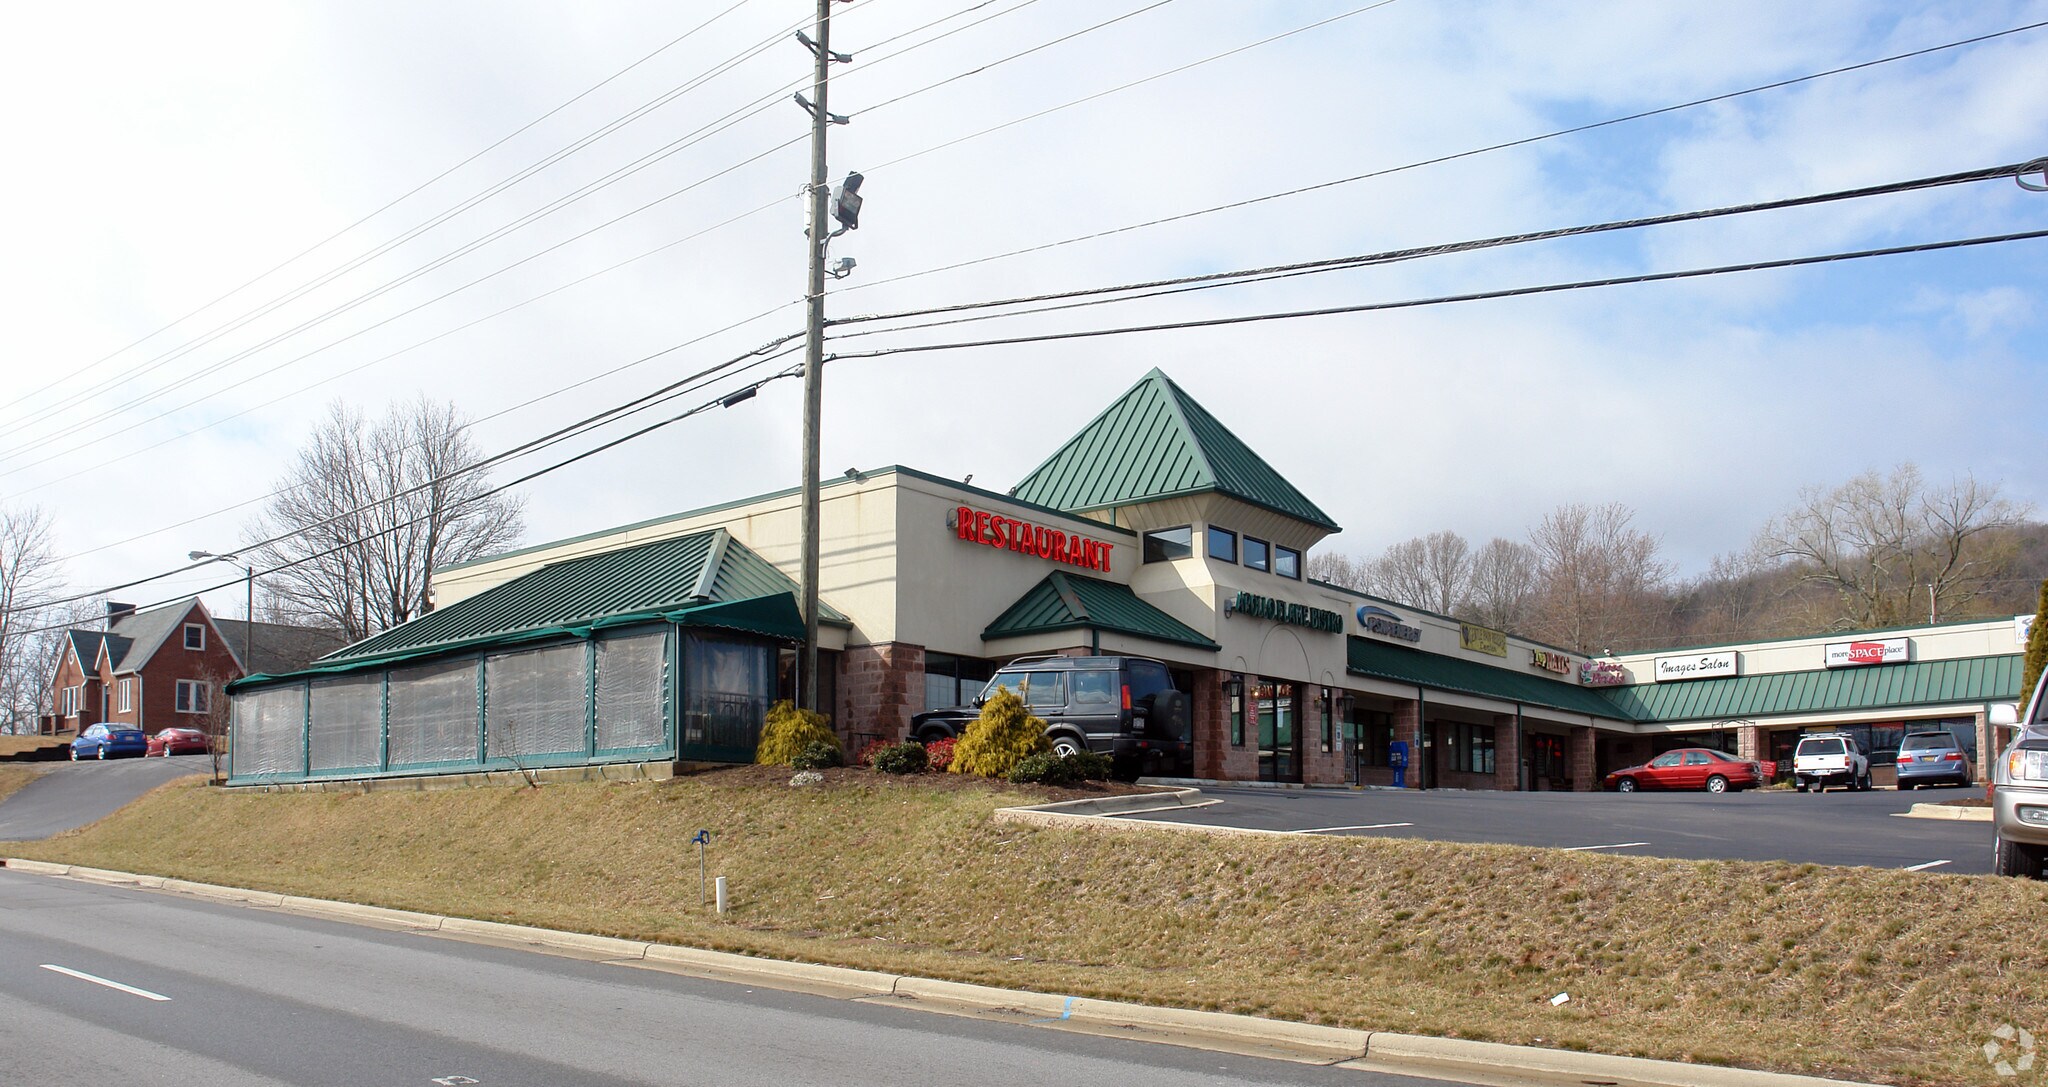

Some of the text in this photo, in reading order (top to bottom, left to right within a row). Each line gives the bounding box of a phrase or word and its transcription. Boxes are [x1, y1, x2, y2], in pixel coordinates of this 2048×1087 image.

[957, 506, 1113, 573] RESTAURANT
[1236, 591, 1344, 635] APOLLO FLAME BISTRO
[1831, 646, 1902, 659] more SPACE place
[1546, 651, 1571, 675] NAILS
[1597, 661, 1623, 672] Rose
[1661, 657, 1730, 676] Images Salon
[1591, 672, 1625, 684] Petals
